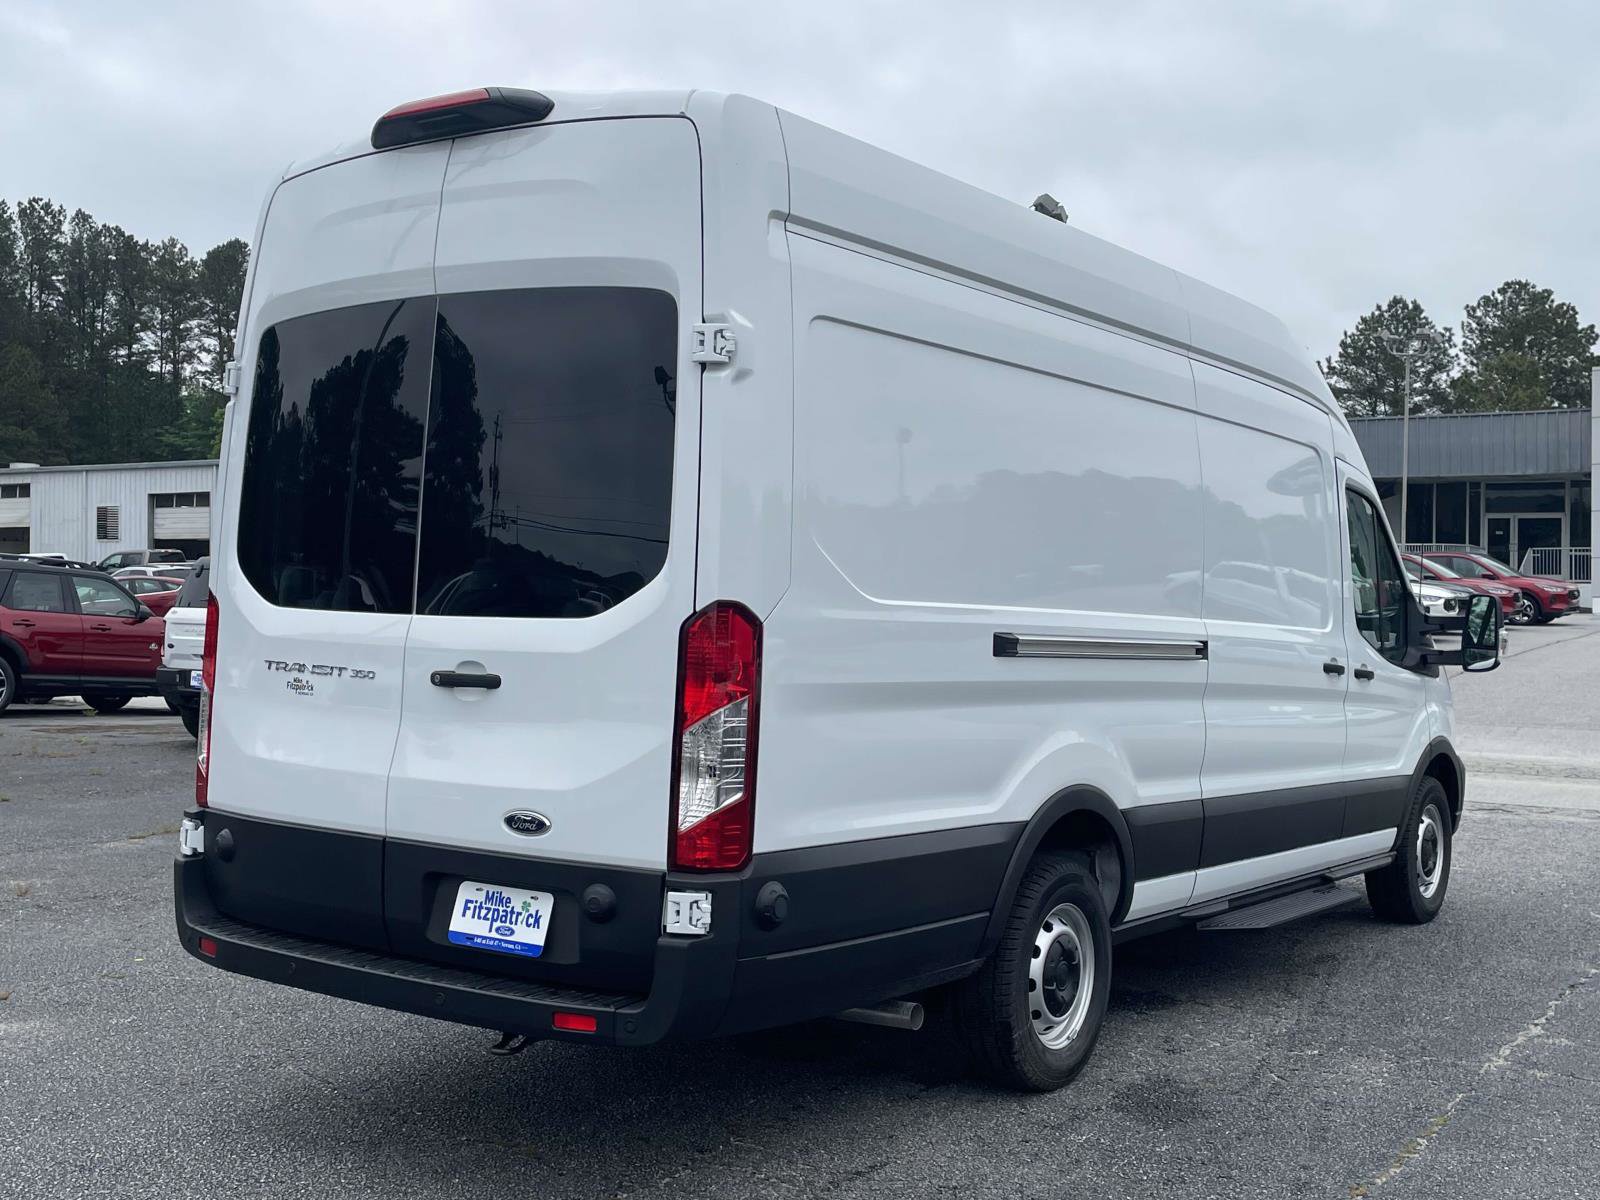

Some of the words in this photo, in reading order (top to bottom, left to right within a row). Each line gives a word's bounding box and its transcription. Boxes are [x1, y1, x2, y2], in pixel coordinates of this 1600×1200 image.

[264, 659, 349, 677] TRANSIT
[349, 668, 377, 680] 350
[286, 681, 314, 695] Fitzpatrick
[511, 815, 539, 831] Ford
[484, 889, 512, 908] Mike
[461, 898, 543, 934] Fitzpatrick
[496, 927, 513, 936] Ford
